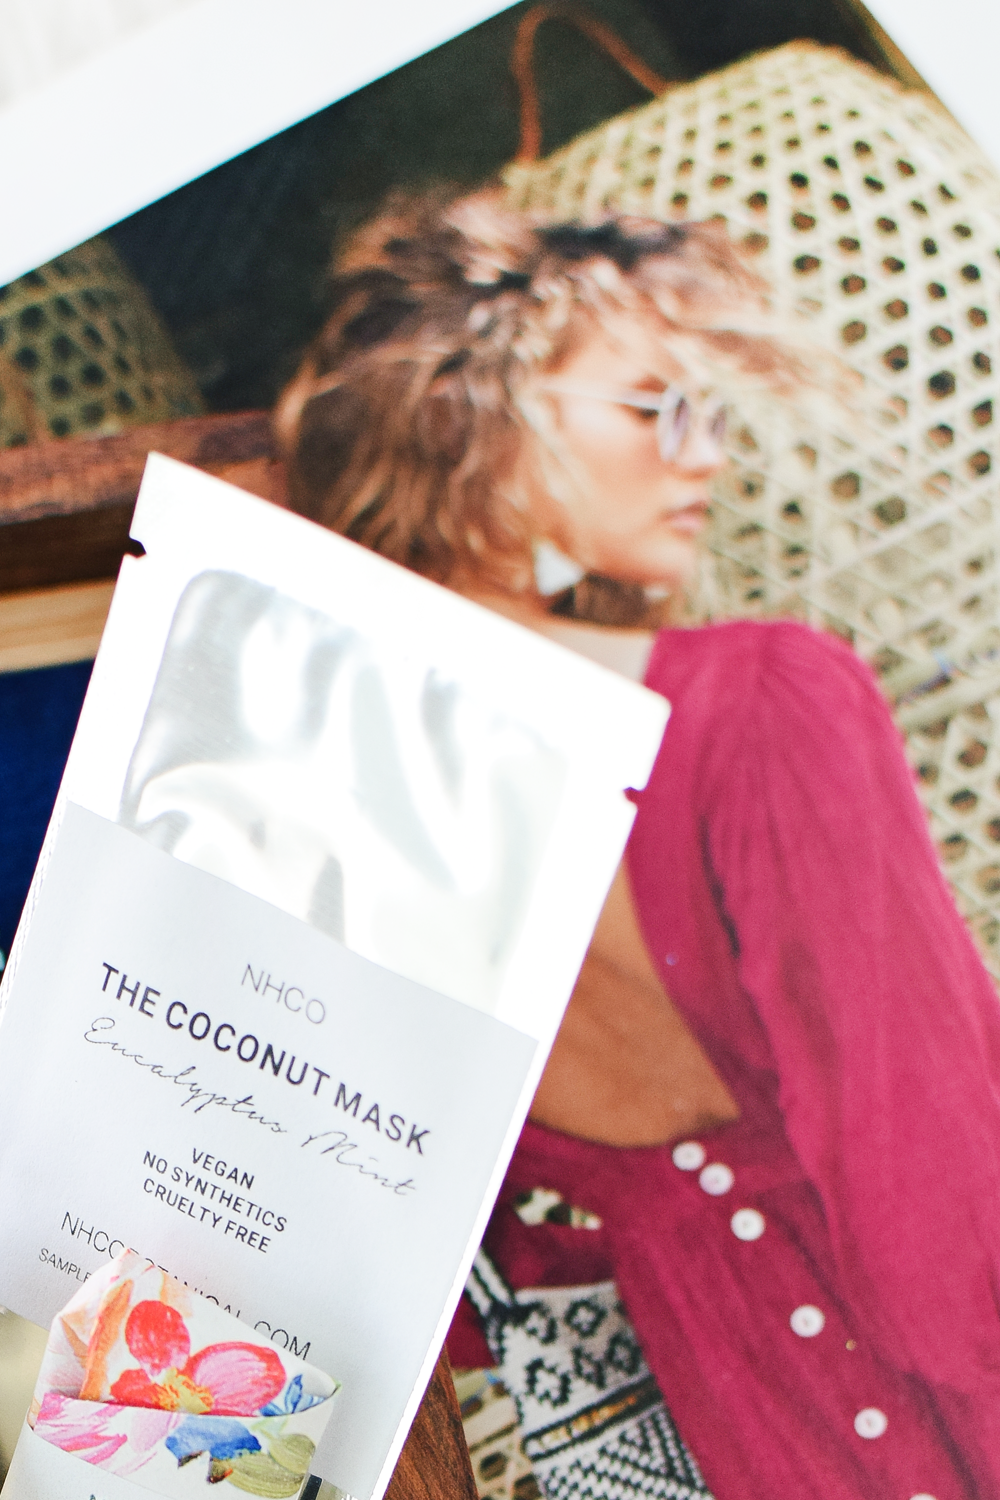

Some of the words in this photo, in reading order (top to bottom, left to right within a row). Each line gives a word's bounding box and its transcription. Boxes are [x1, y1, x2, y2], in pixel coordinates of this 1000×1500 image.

[241, 964, 327, 1025] NHCO
[101, 963, 161, 1018] THE
[166, 1001, 331, 1098] COCONUT
[333, 1083, 432, 1156] MASK
[84, 1017, 288, 1134] Eucalyptus
[301, 1130, 417, 1196] Mint
[142, 1150, 168, 1175] NO
[171, 1165, 288, 1232] SYNTHETICS
[191, 1147, 255, 1190] VEGAN
[143, 1178, 223, 1230] CRUELTY
[224, 1221, 272, 1253] FREE
